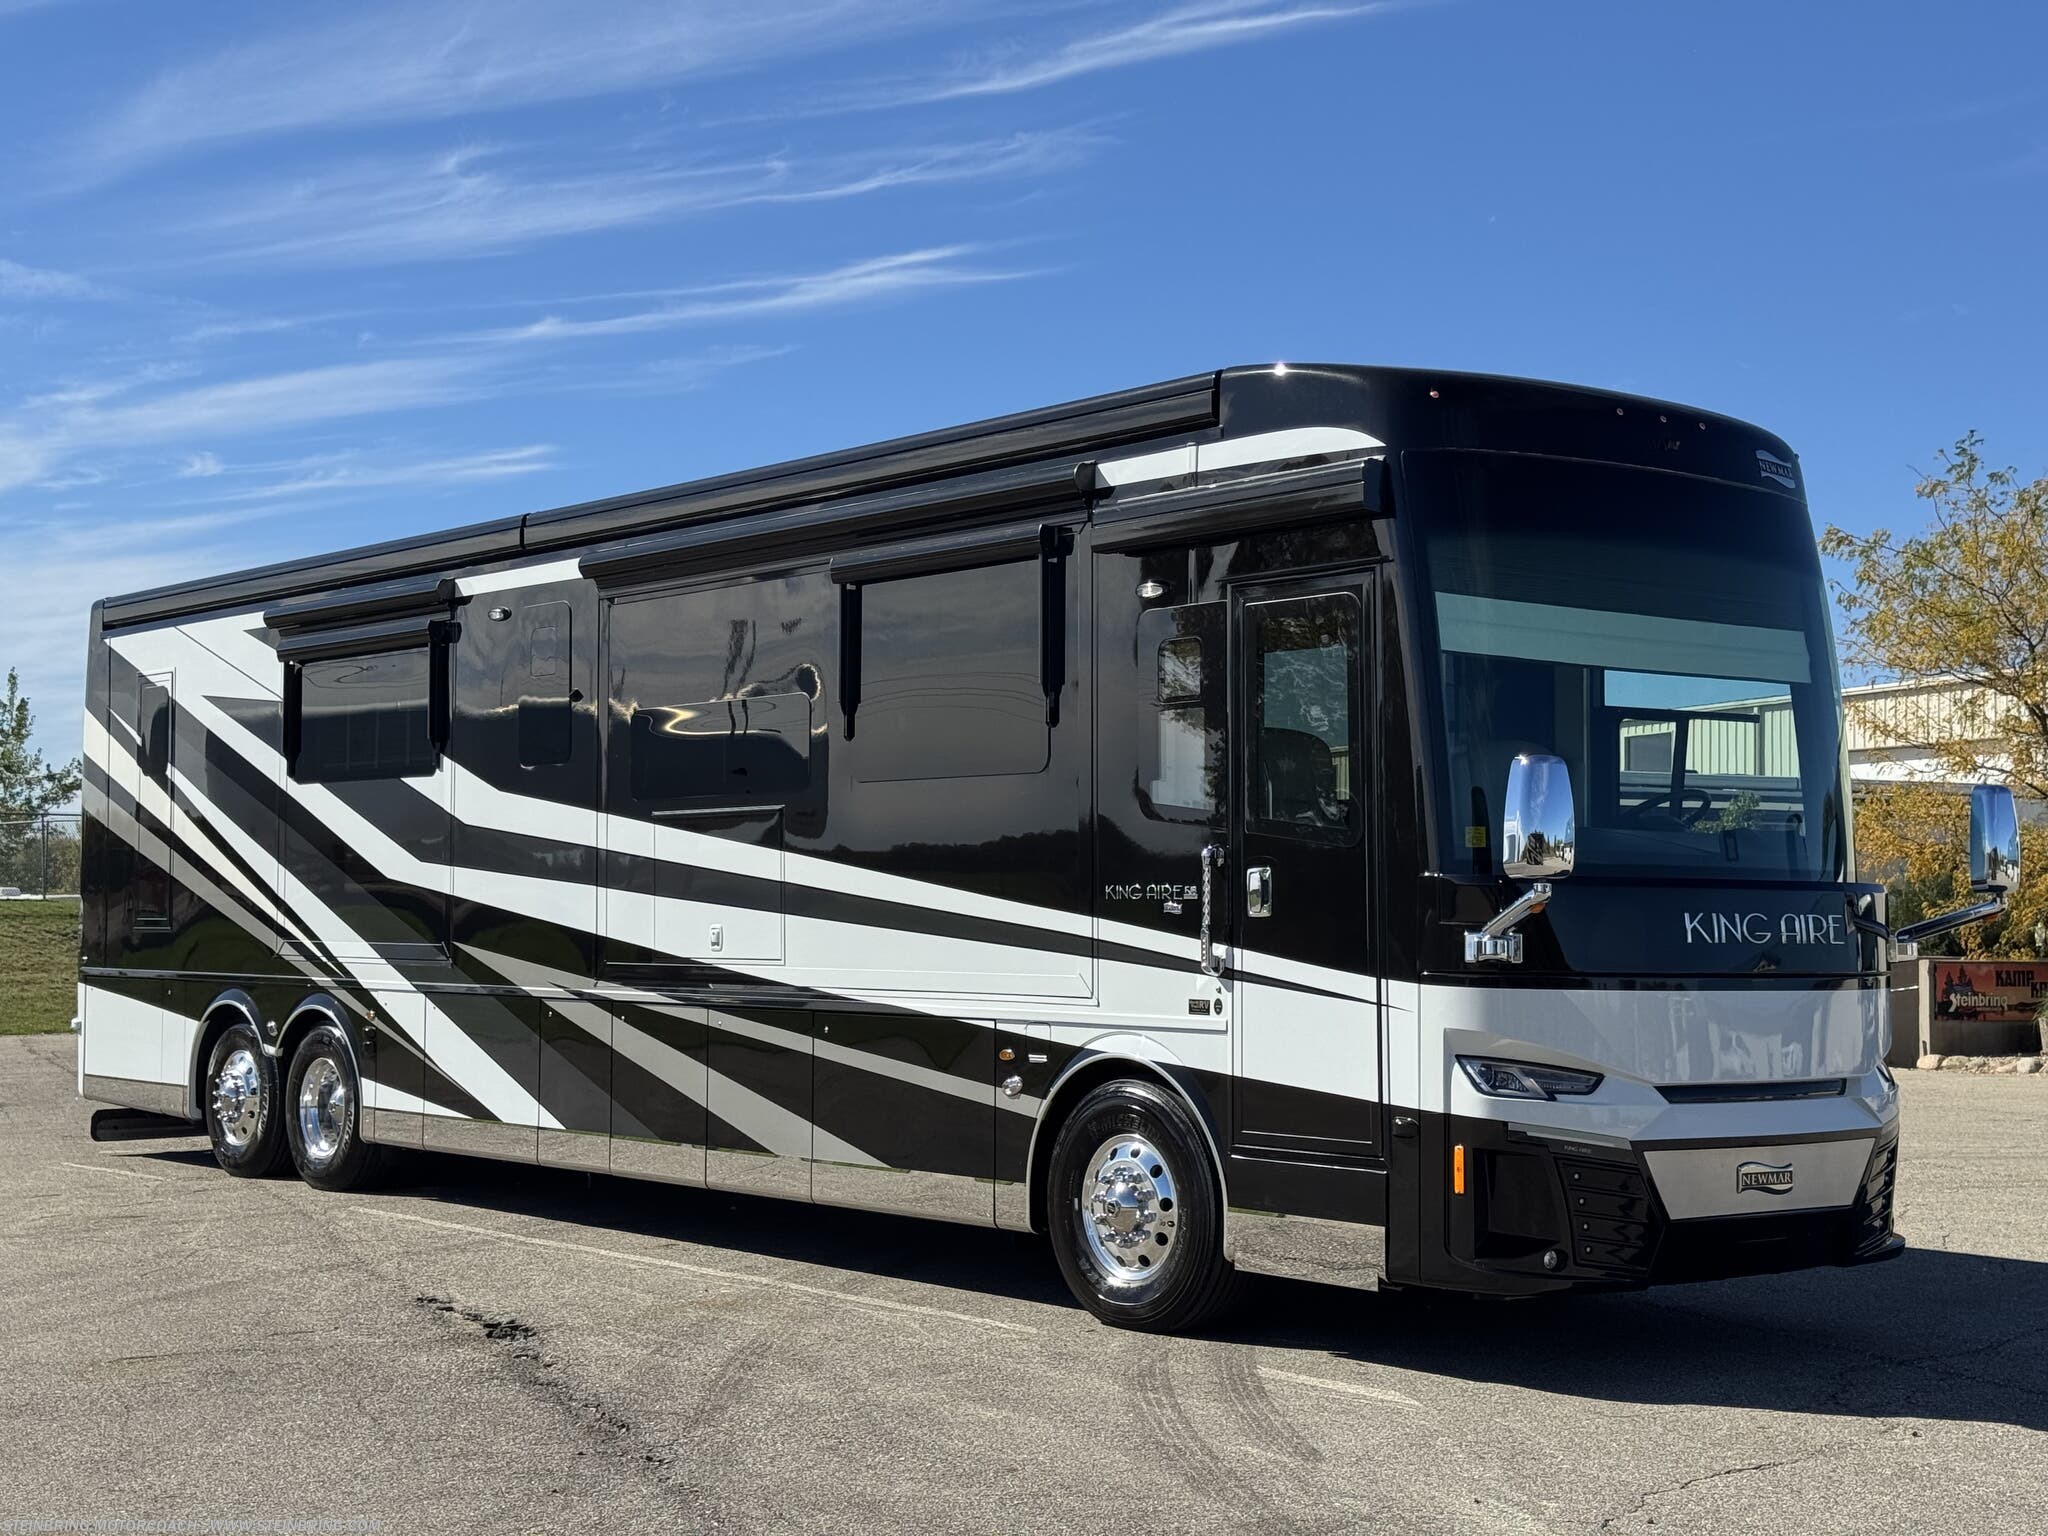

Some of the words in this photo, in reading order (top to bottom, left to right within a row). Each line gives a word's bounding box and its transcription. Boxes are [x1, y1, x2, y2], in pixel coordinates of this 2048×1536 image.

[1758, 459, 1793, 479] NEWMAR
[1105, 883, 1143, 900] KING
[1146, 883, 1183, 900] AIRE
[1684, 912, 1773, 944] KING
[1780, 913, 1845, 945] AIRE
[1948, 992, 2008, 1013] Steinbring
[1742, 1172, 1792, 1186] NEWMAR
